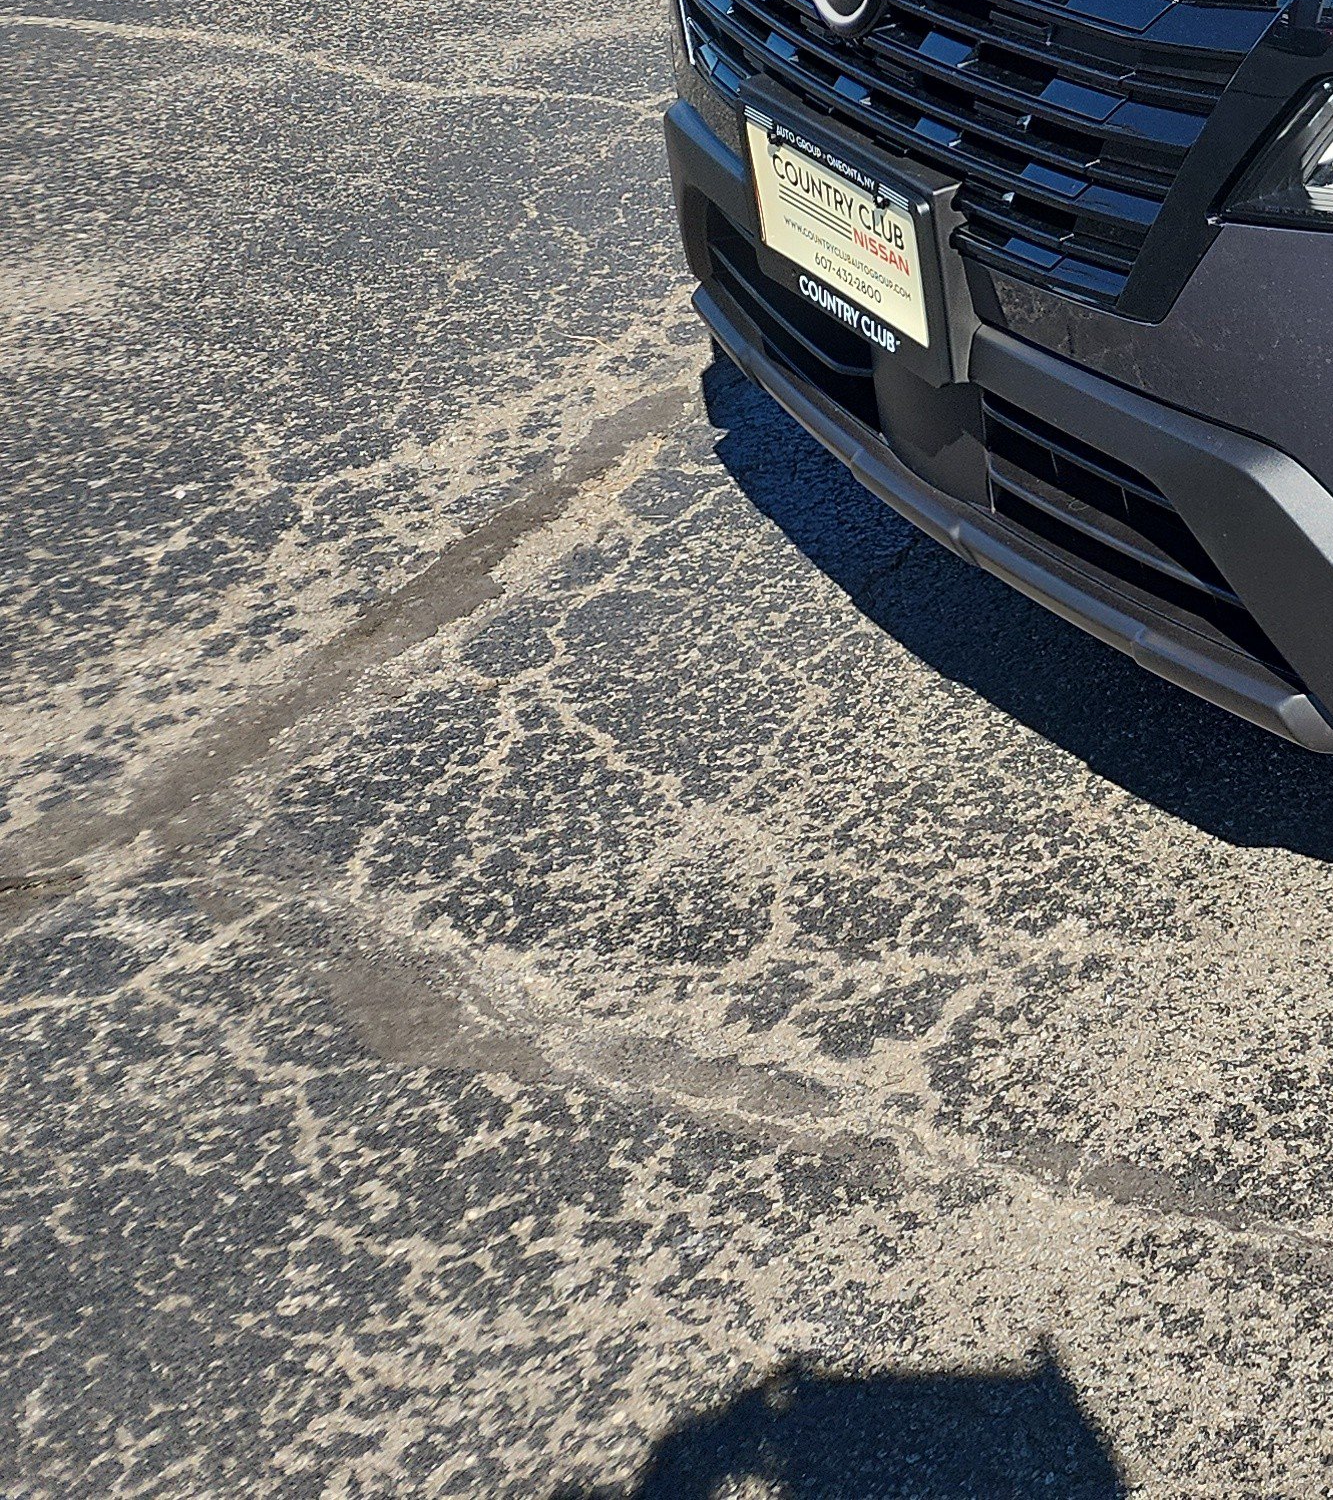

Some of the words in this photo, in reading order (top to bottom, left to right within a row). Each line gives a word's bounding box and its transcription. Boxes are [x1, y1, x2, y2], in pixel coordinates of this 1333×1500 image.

[776, 124, 796, 144] AUTO
[796, 135, 822, 159] GROUP
[772, 154, 854, 220] COUNTRY
[858, 203, 905, 251] CLUB
[814, 251, 883, 304] 607-432-2800
[853, 227, 911, 277] NISSAN
[798, 274, 860, 329] COUNTRY
[860, 314, 897, 353] CLUB
